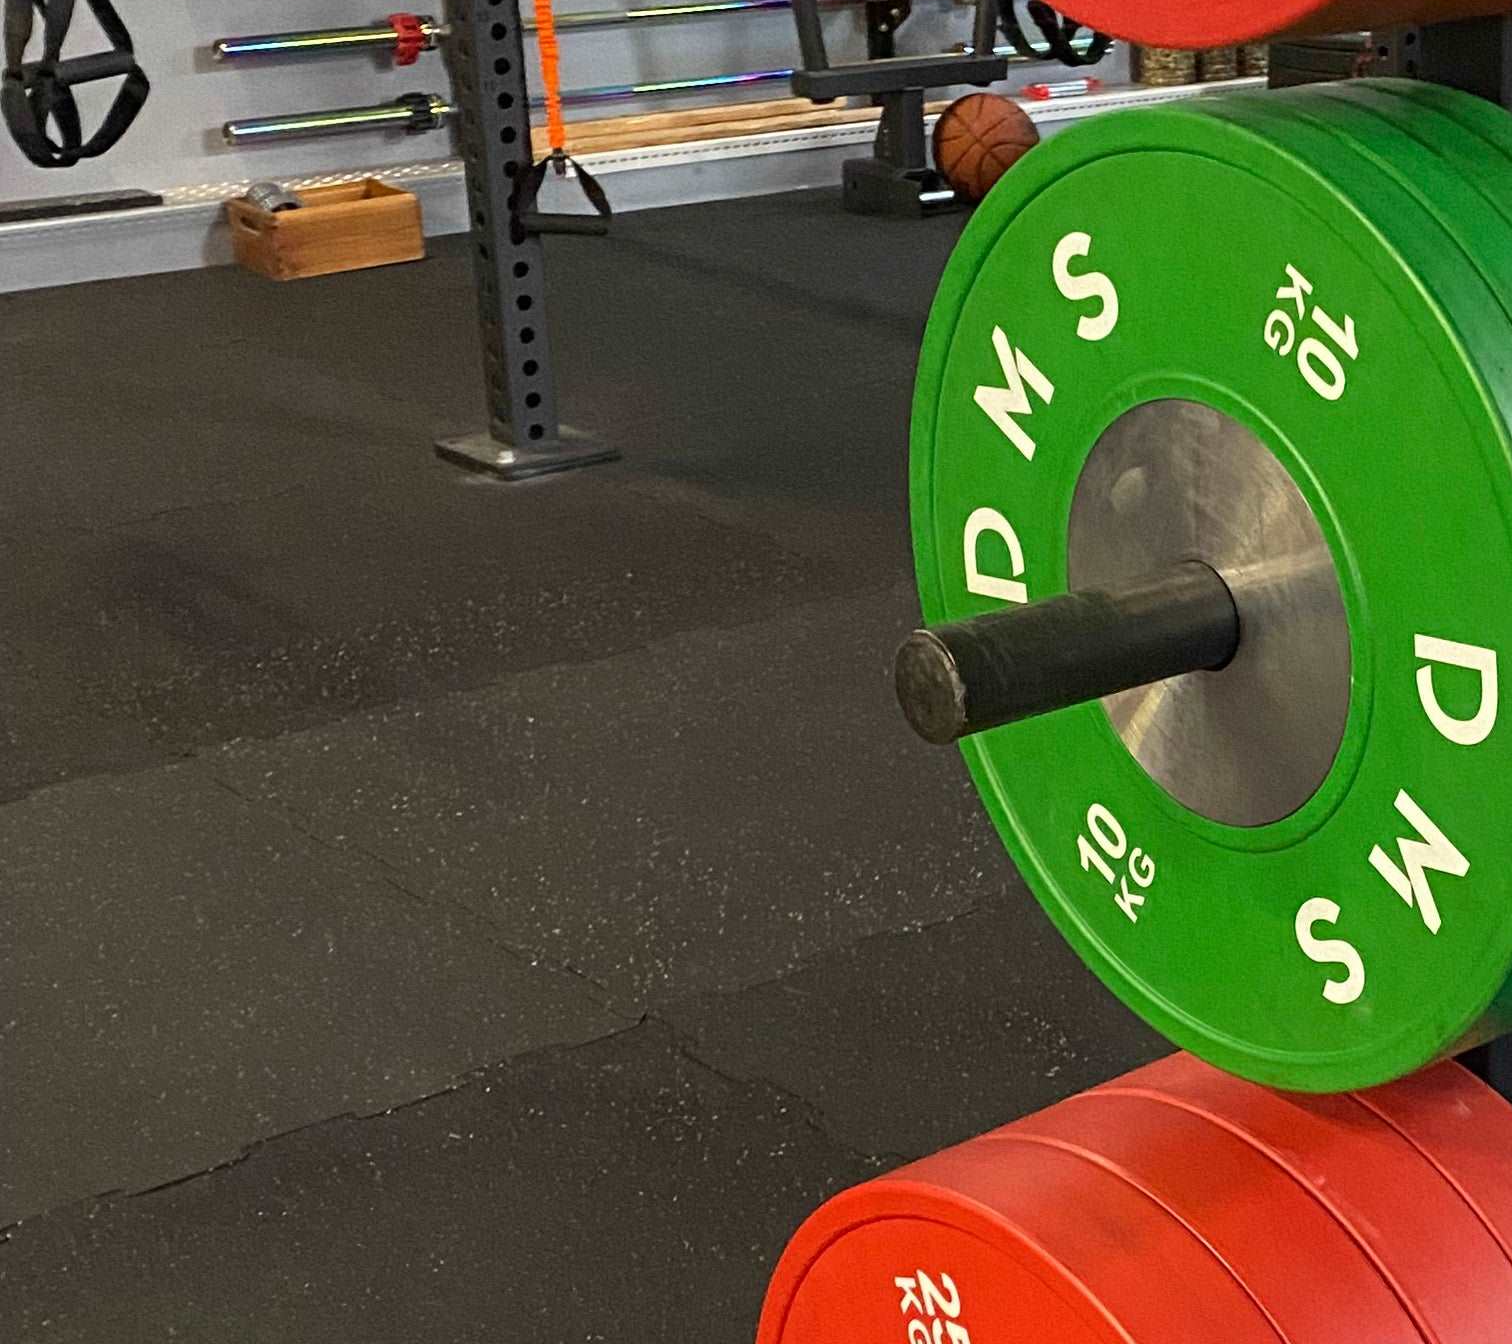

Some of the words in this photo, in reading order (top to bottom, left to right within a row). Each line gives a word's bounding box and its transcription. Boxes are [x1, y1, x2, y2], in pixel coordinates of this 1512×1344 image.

[1263, 263, 1314, 358] KG
[1297, 305, 1360, 401] 10
[963, 231, 1120, 604] DMS
[1076, 803, 1129, 885] 10
[1295, 633, 1499, 1005] DMS
[1113, 847, 1156, 924] KG
